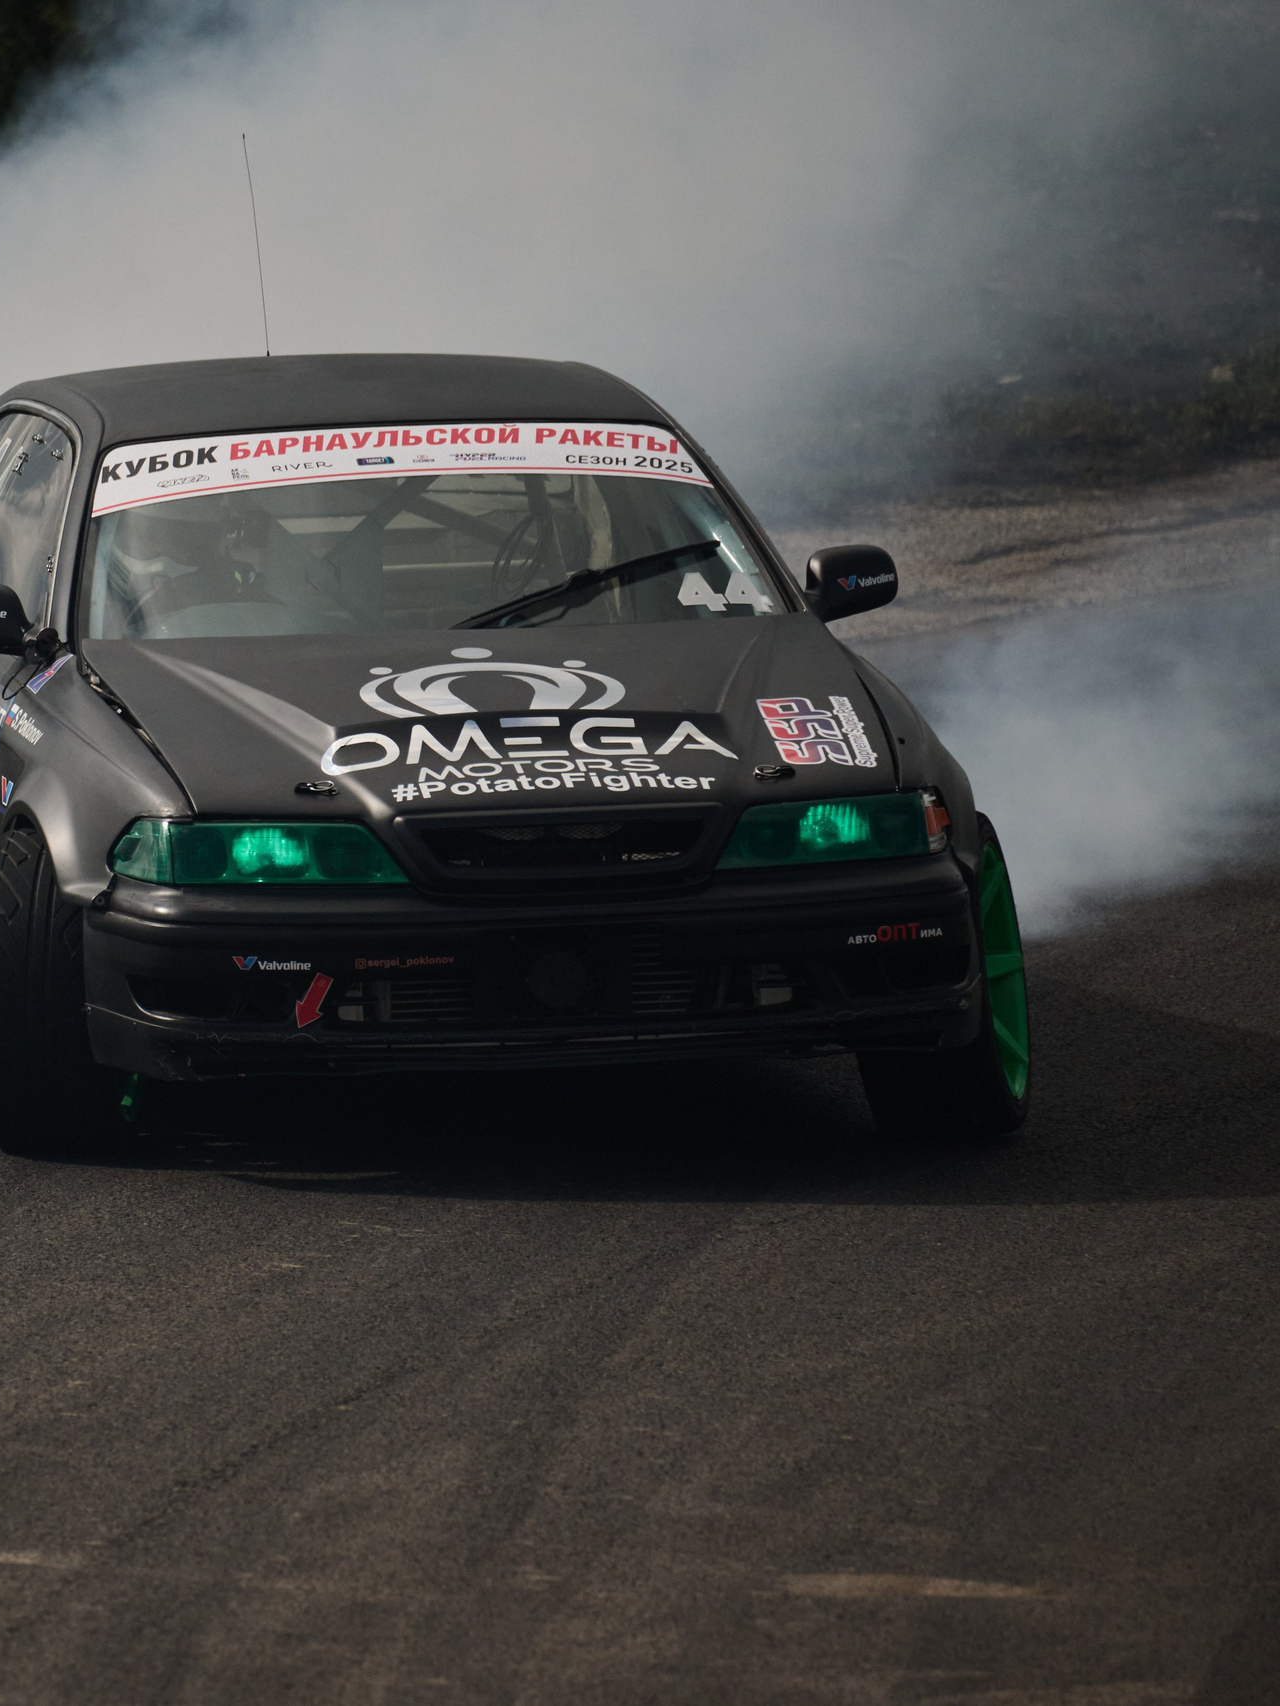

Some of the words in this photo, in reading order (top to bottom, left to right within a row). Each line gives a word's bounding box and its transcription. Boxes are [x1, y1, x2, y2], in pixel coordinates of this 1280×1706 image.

[101, 446, 219, 484] КУБОК
[230, 424, 520, 461] БАРНАУЛЬСКОЙ
[535, 427, 678, 455] РАКЕТЫ
[565, 454, 627, 467] СЕЗОН
[634, 455, 694, 474] 2025
[272, 461, 333, 473] RIVER
[678, 572, 774, 612] 44
[858, 573, 895, 588] Valvoline
[832, 697, 853, 715] Power
[843, 710, 864, 734] Super
[321, 717, 739, 776] OMEGA
[851, 733, 875, 767] Supreme
[418, 758, 661, 783] MOTORS
[391, 772, 716, 803] #PotatoFighter
[257, 960, 311, 972] Valvoline
[367, 956, 455, 969] sergei_poklonov
